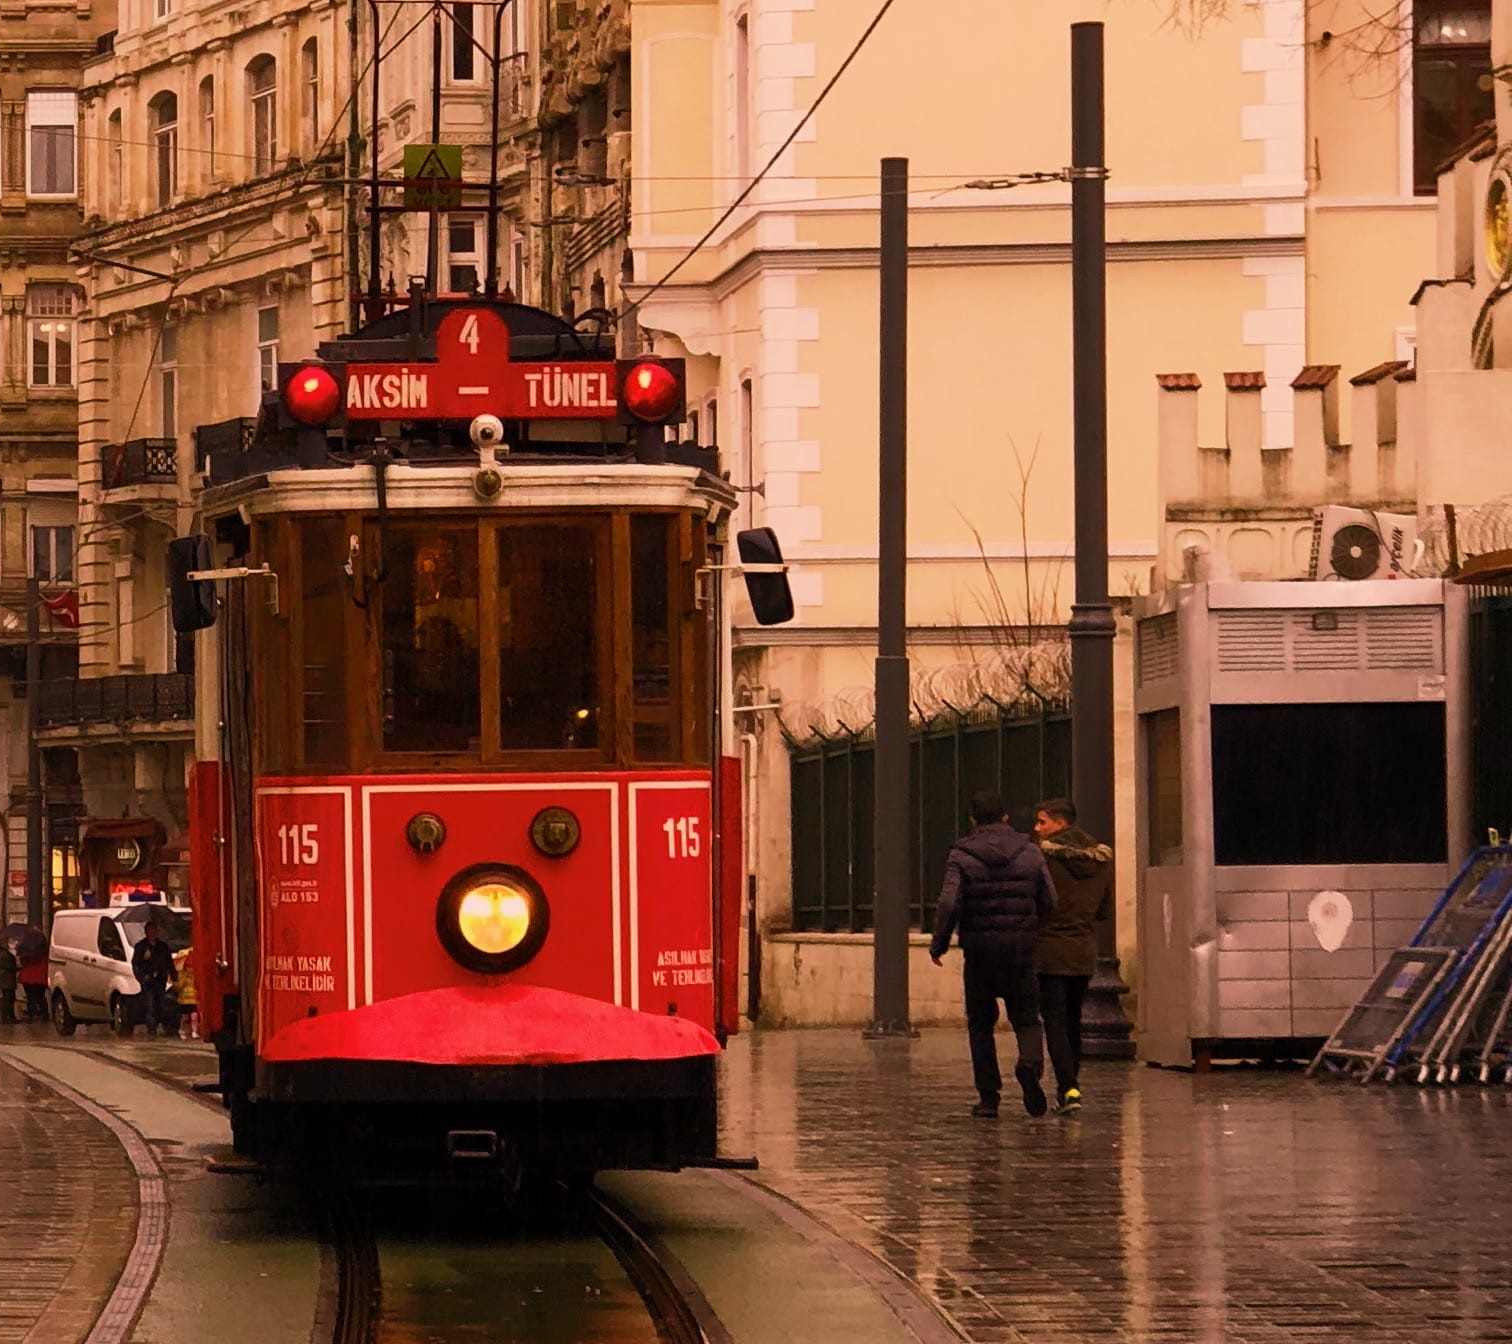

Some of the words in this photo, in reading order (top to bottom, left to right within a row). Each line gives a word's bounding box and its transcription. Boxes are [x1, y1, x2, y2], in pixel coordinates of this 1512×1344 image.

[459, 314, 480, 354] 4
[524, 366, 618, 407] TÜNEL
[278, 824, 319, 865] 115
[662, 816, 701, 859] 115
[297, 956, 332, 972] YASAK
[652, 970, 668, 987] VE
